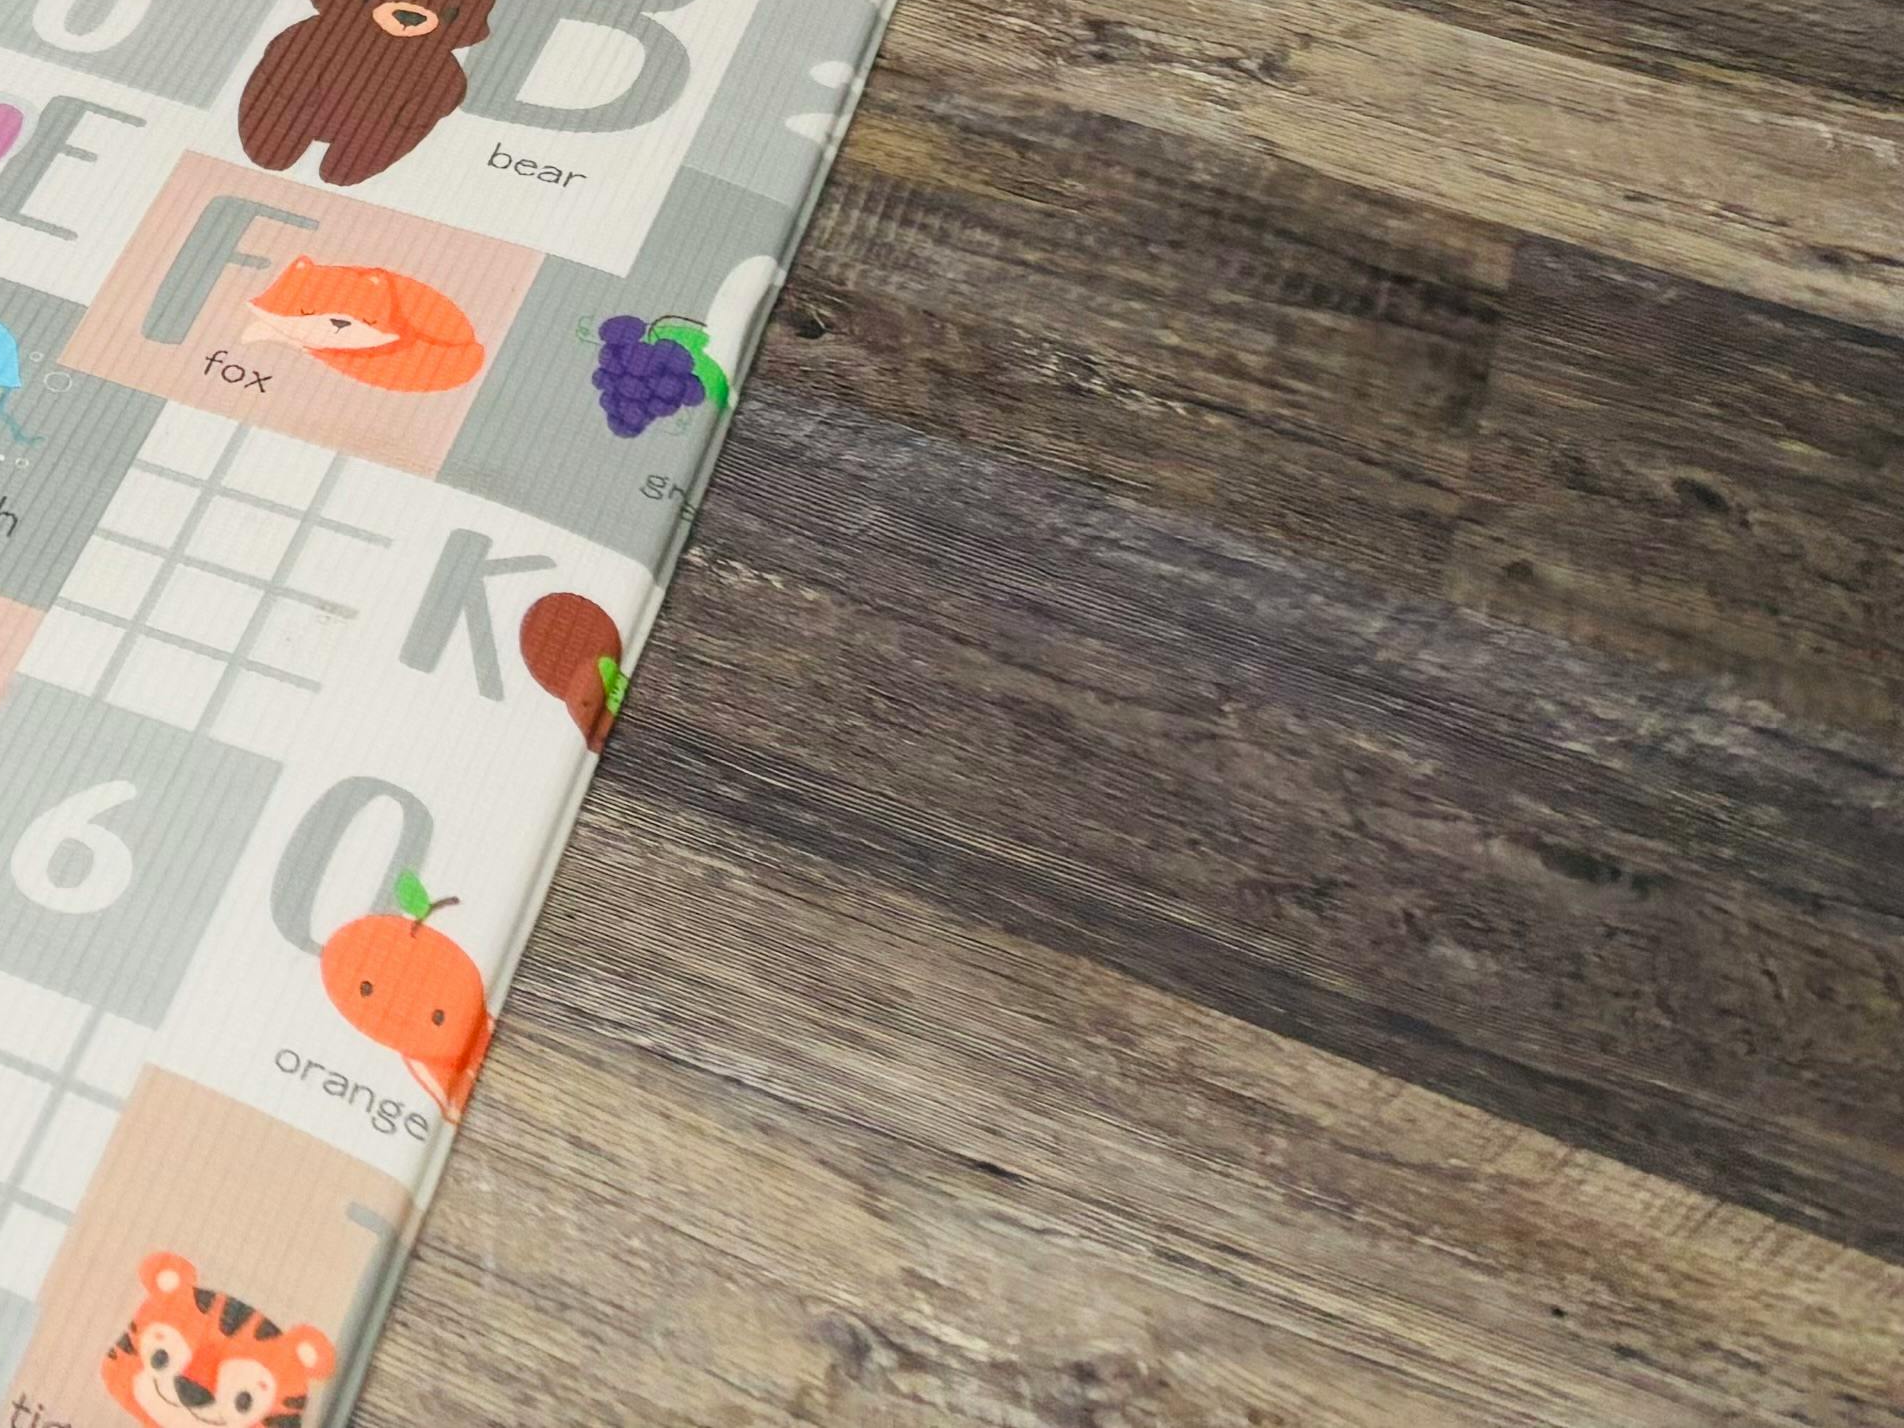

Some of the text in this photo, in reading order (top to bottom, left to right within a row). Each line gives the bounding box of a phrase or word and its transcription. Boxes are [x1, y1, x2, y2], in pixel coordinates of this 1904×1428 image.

[485, 141, 590, 191] bear
[141, 194, 321, 345] F
[202, 349, 274, 396] fox
[395, 527, 558, 703] K
[9, 778, 138, 917] 6
[273, 1042, 434, 1143] orange
